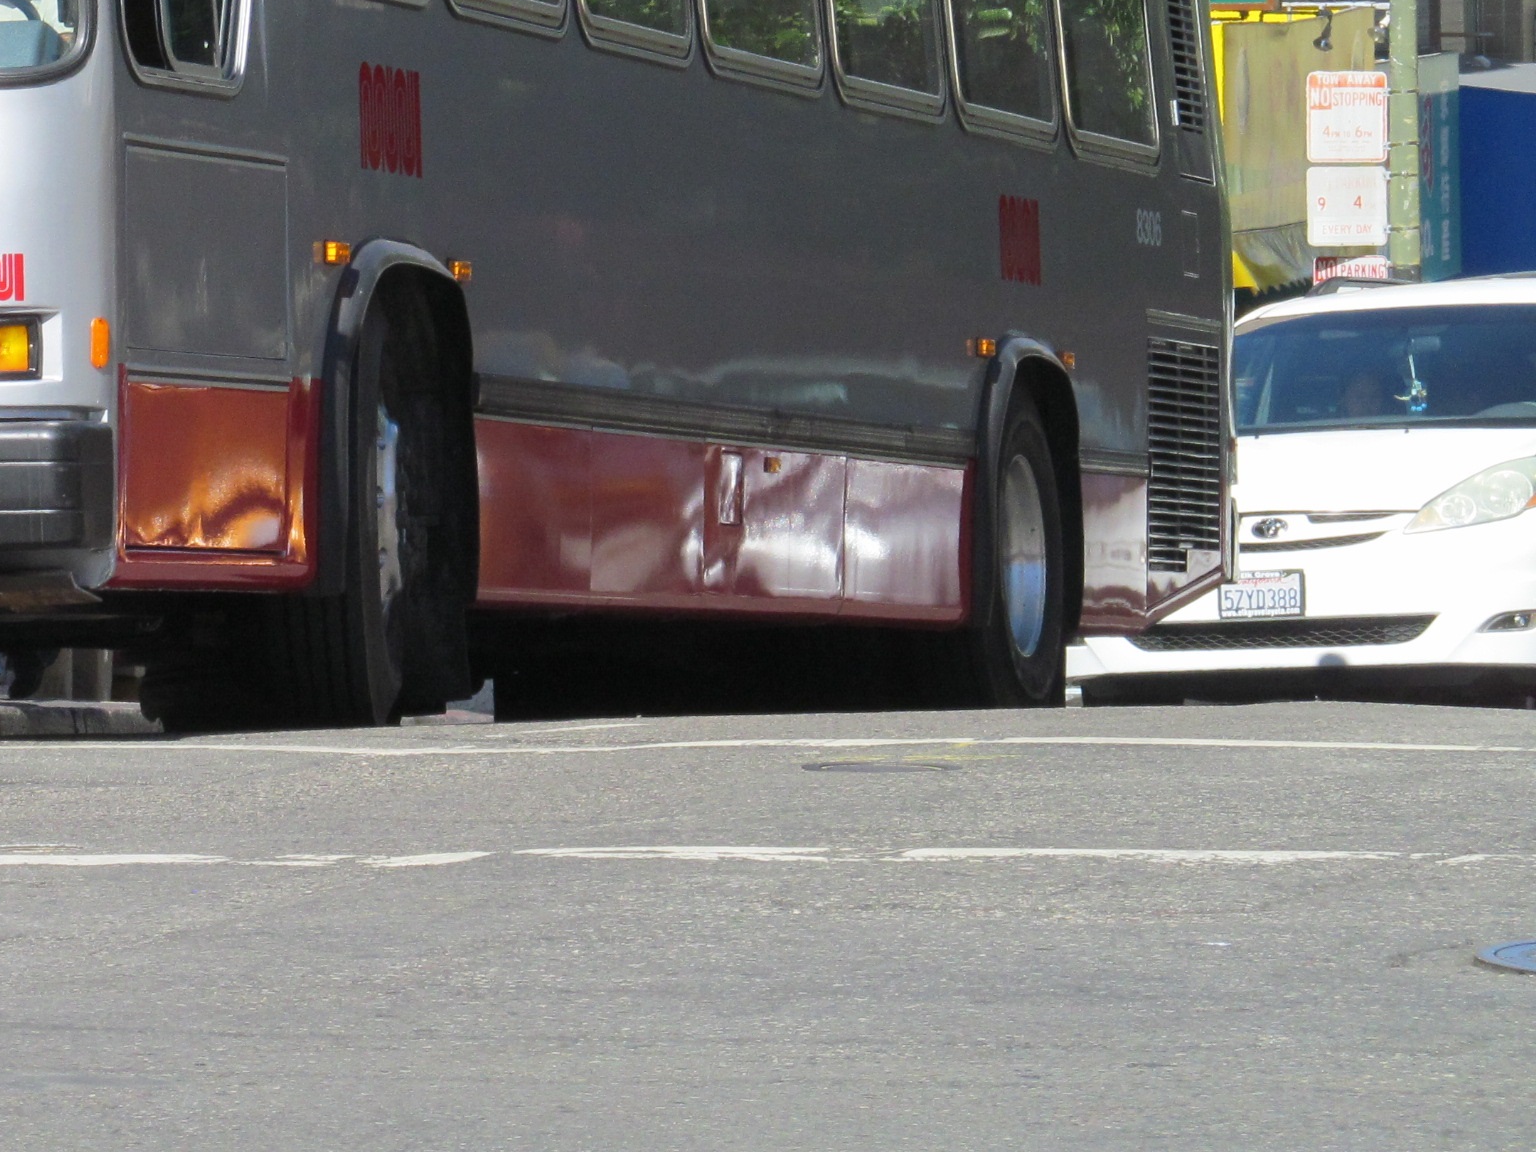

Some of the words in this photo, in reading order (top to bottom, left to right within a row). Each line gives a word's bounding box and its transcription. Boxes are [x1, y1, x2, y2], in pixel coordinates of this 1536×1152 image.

[1318, 74, 1338, 85] TOW
[1346, 74, 1376, 84] AWAY
[1311, 88, 1331, 107] NO
[1333, 91, 1382, 107] STOPPING
[1137, 208, 1161, 247] 8306
[1322, 225, 1351, 235] EVERY
[1356, 224, 1373, 234] DAY
[1340, 263, 1385, 279] PARKING
[1224, 587, 1298, 611] 5ZYD388
